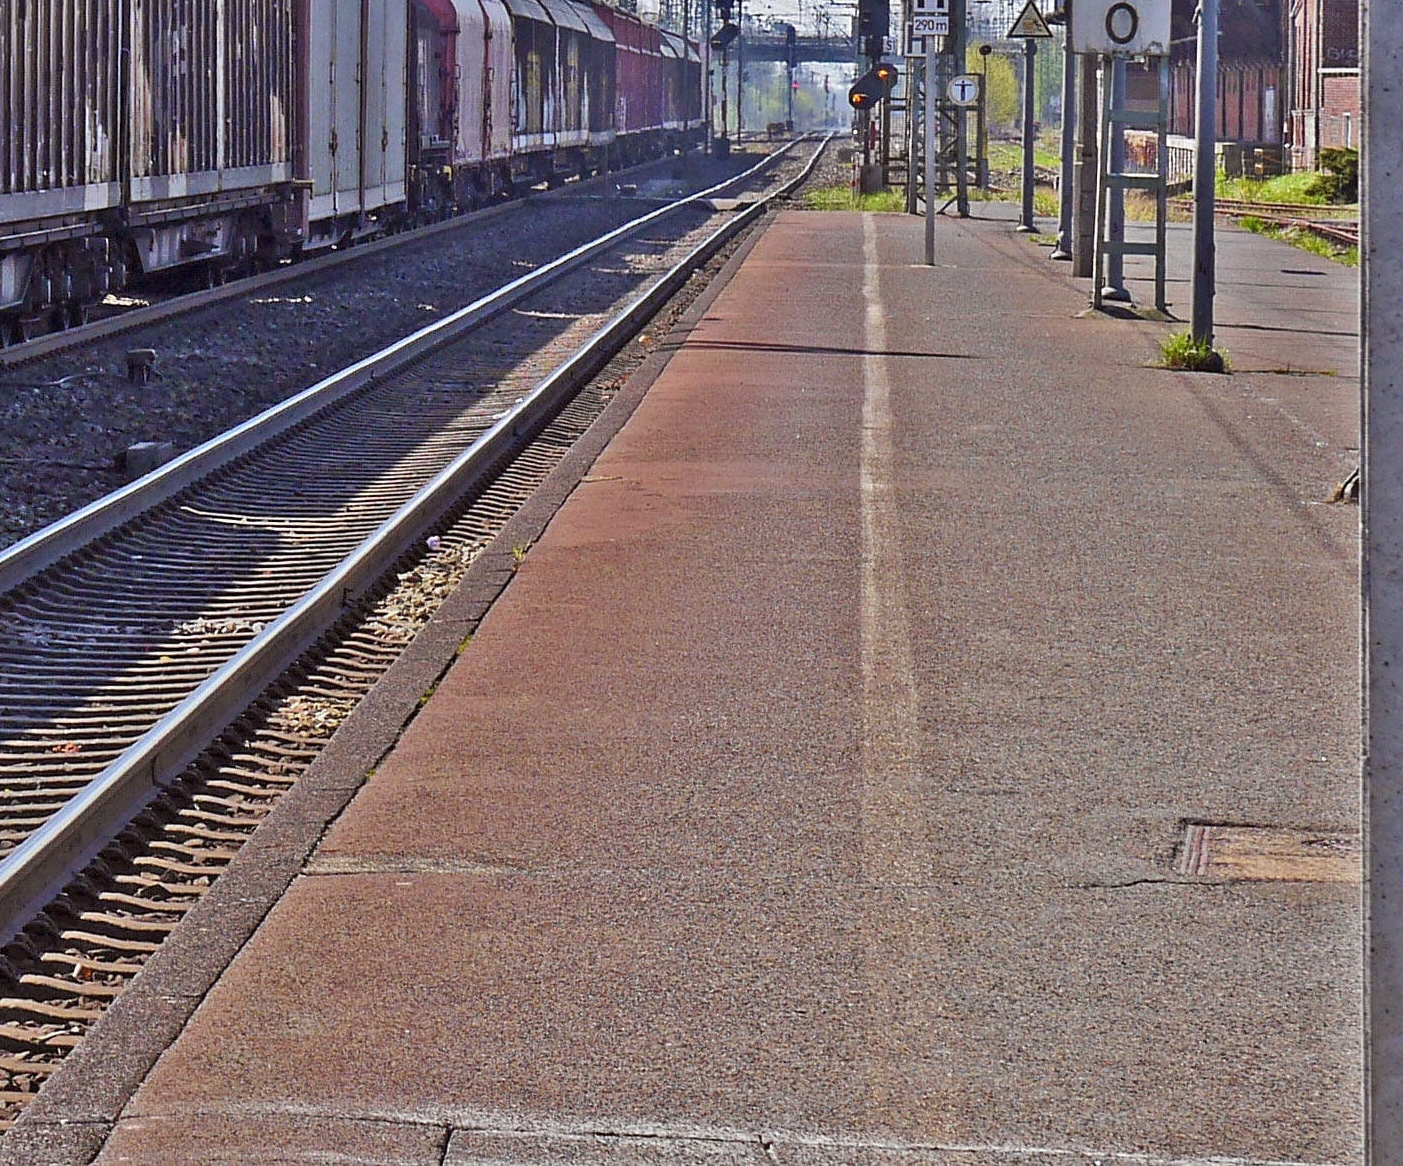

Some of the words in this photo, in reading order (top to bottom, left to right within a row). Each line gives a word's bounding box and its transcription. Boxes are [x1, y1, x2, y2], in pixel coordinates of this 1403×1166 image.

[914, 19, 935, 31] 290
[936, 21, 948, 31] m
[1105, 2, 1139, 44] 0
